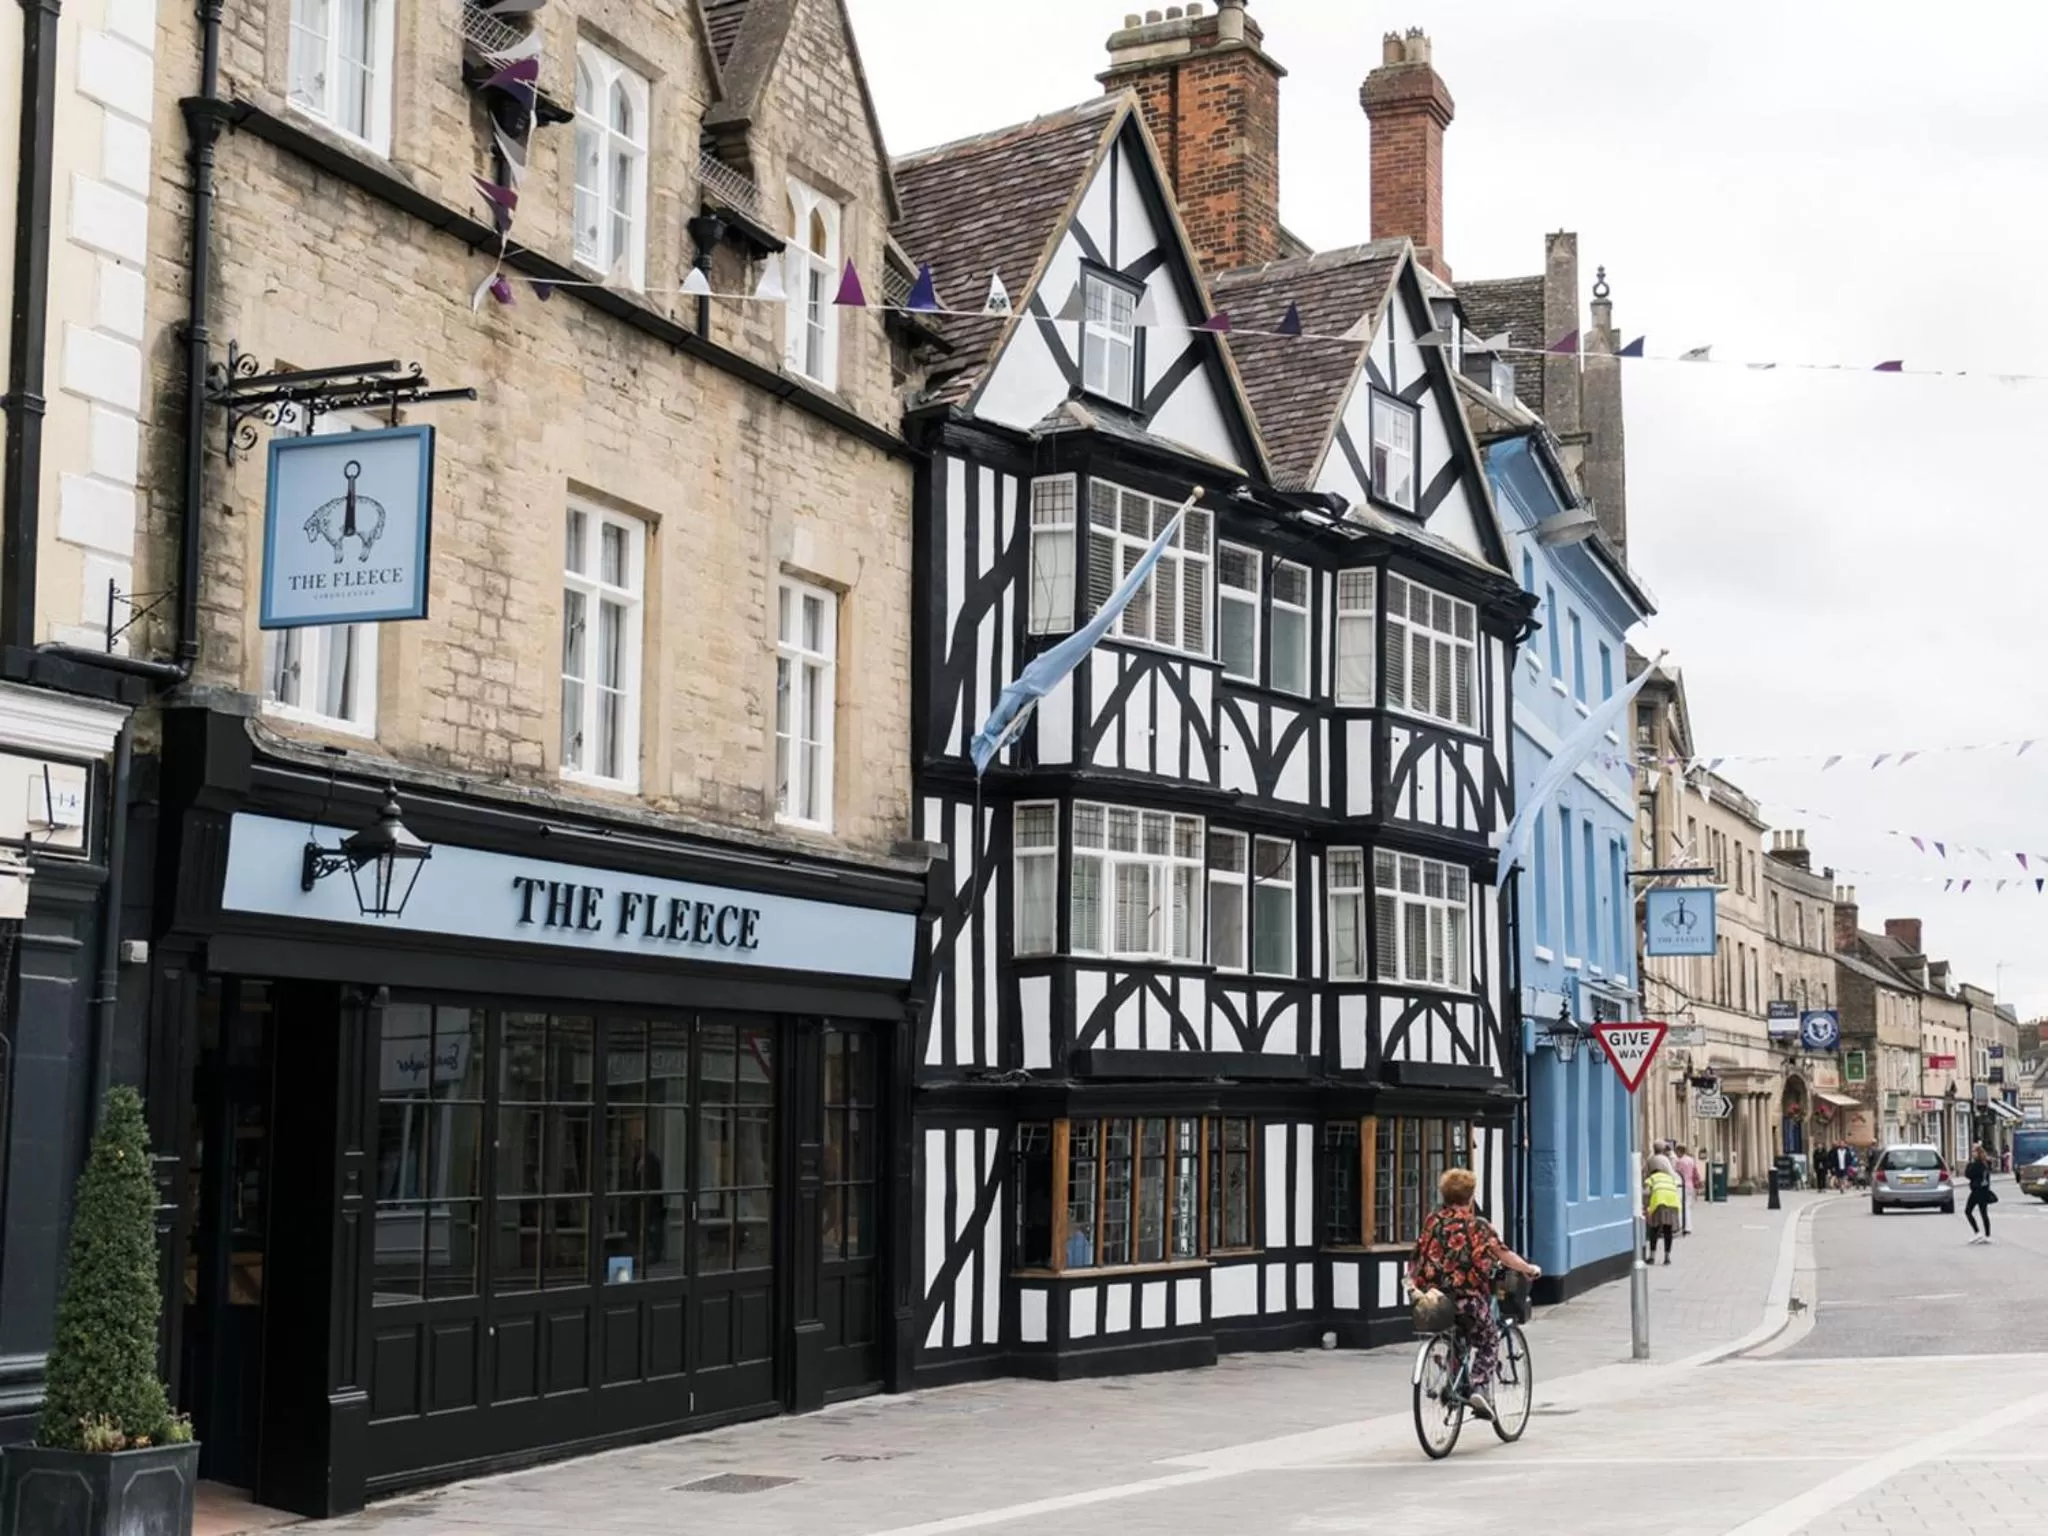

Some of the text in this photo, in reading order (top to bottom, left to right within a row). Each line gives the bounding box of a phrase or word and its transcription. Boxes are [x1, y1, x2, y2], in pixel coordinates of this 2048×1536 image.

[288, 567, 404, 590] THE FLEECE
[513, 876, 760, 949] THE FLEECE
[1609, 1031, 1650, 1045] GIVE
[1619, 1049, 1643, 1059] WAY
